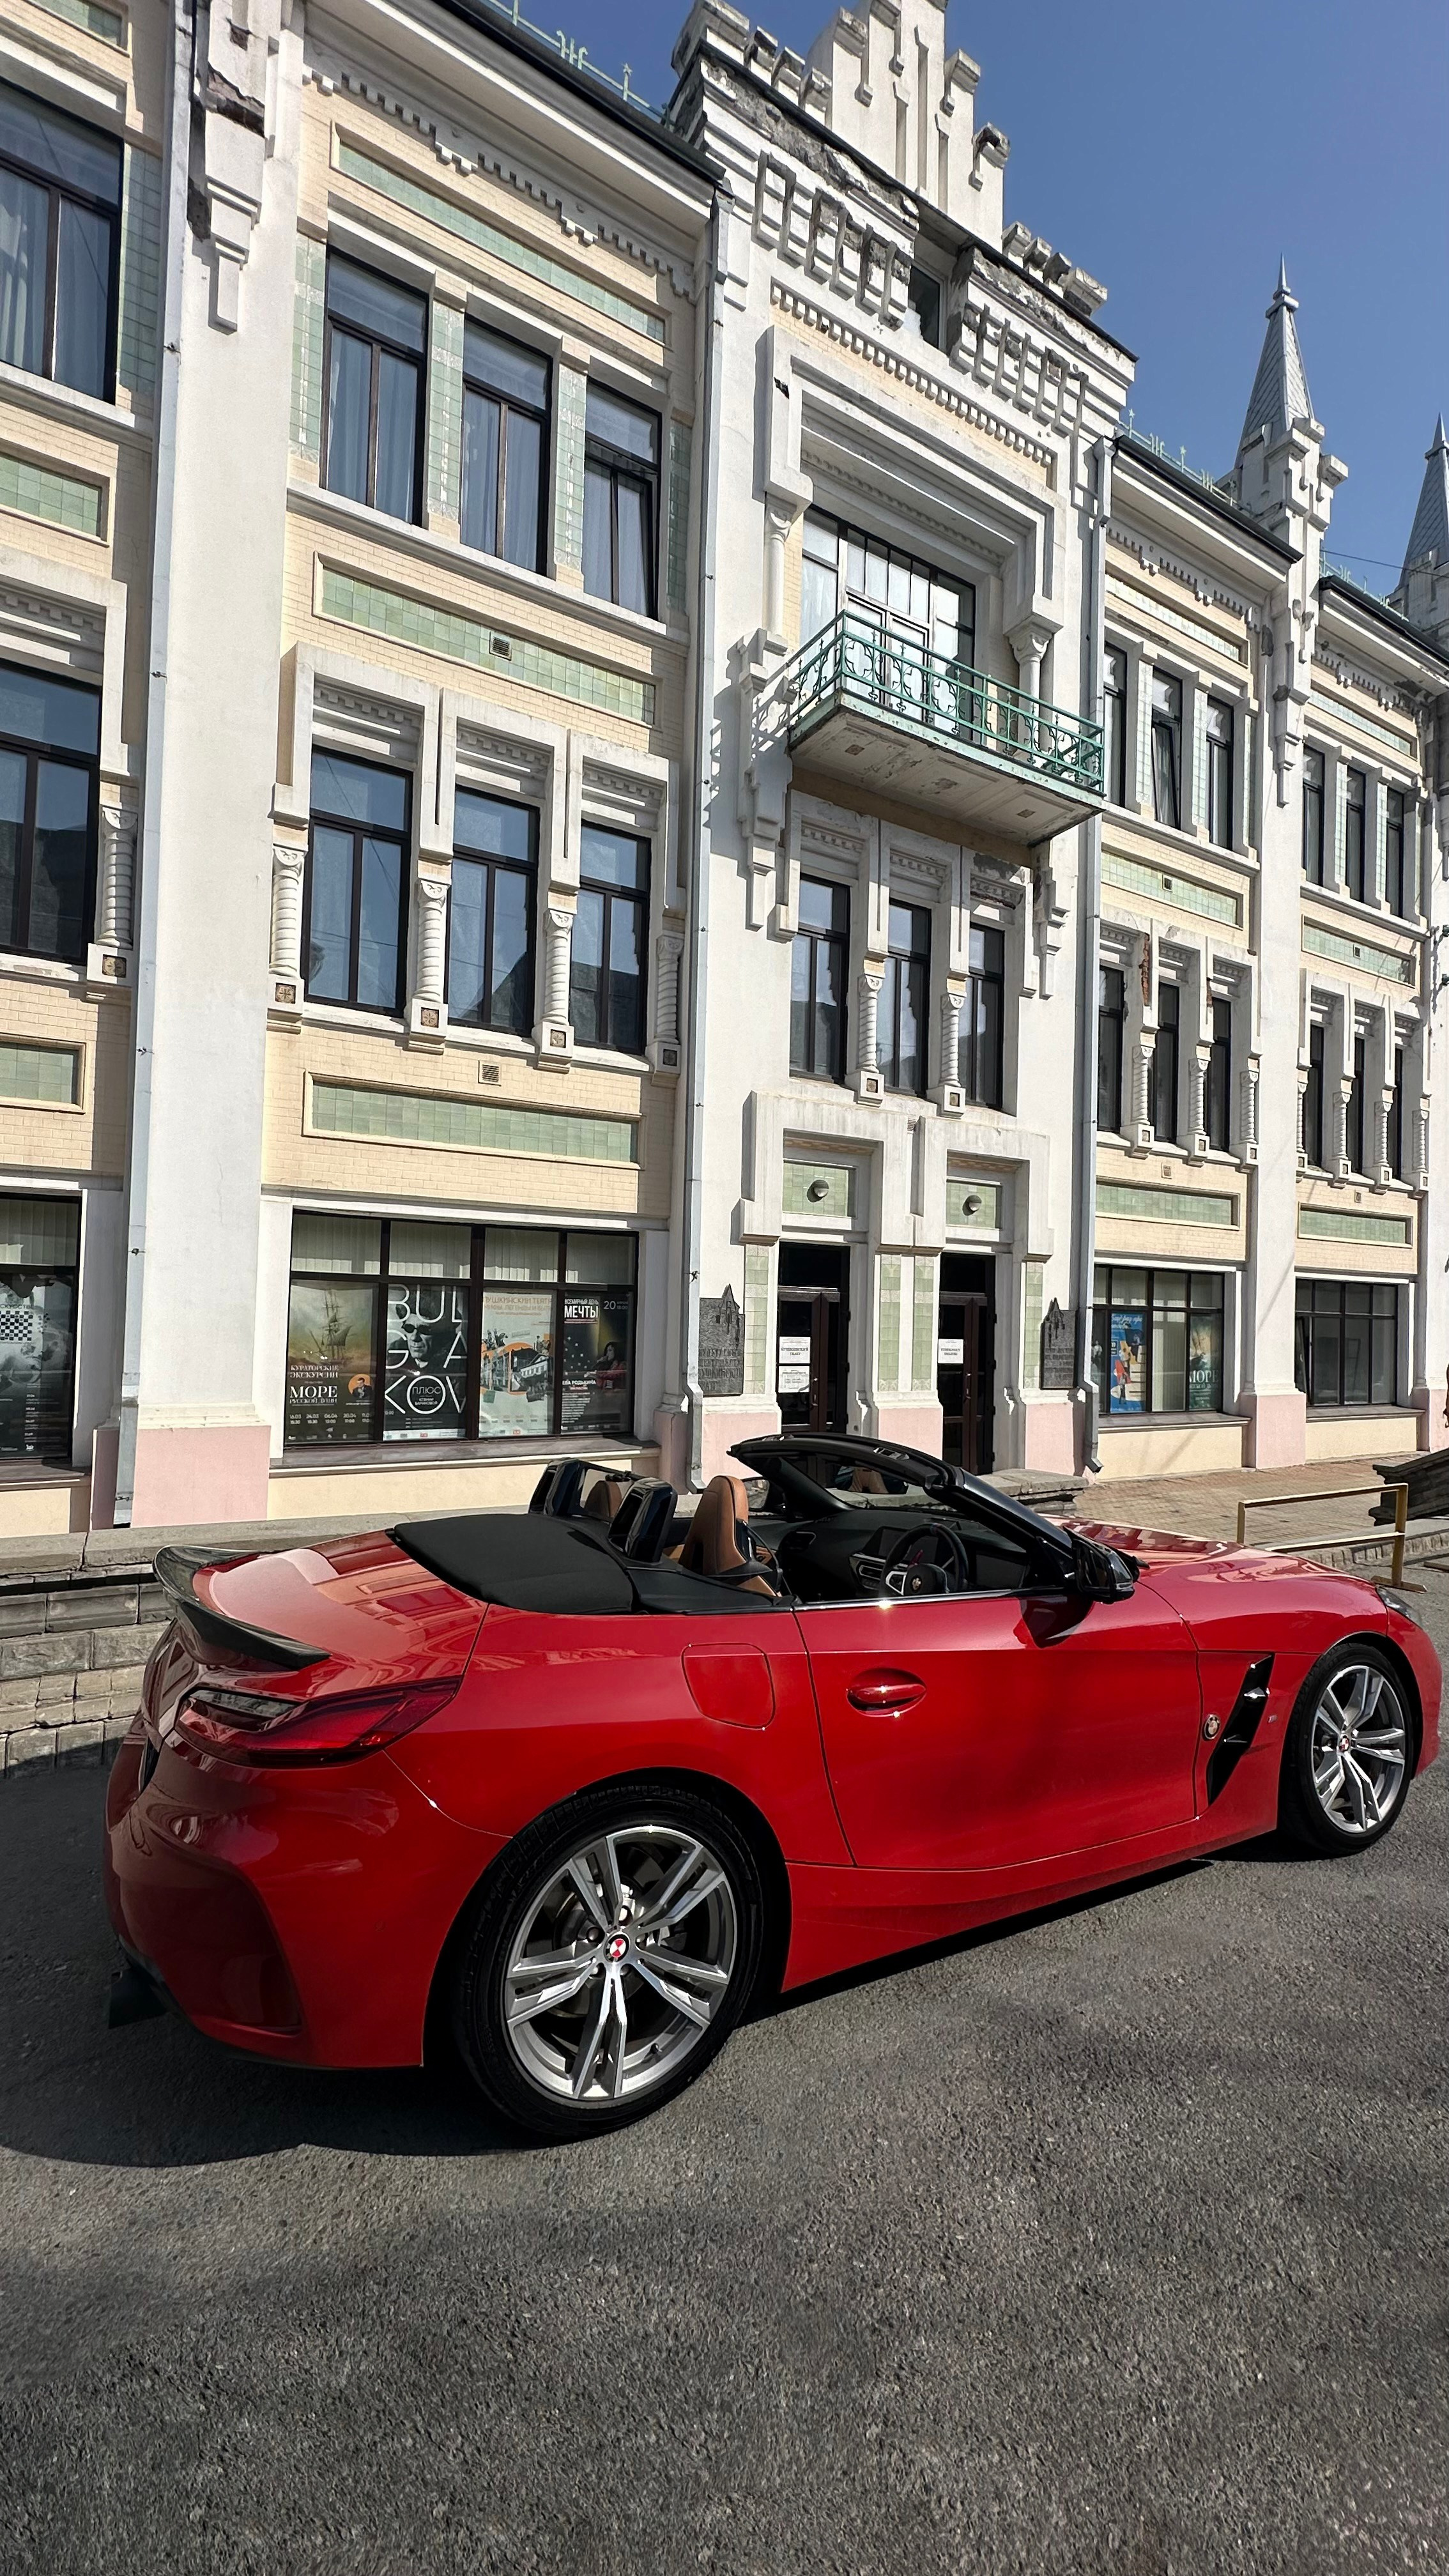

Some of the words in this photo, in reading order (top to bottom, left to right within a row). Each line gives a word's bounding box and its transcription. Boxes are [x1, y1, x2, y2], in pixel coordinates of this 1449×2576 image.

[564, 1305, 599, 1318] МЕЧТЫ
[604, 1301, 616, 1310] 20
[289, 1386, 337, 1398] МОРЕ
